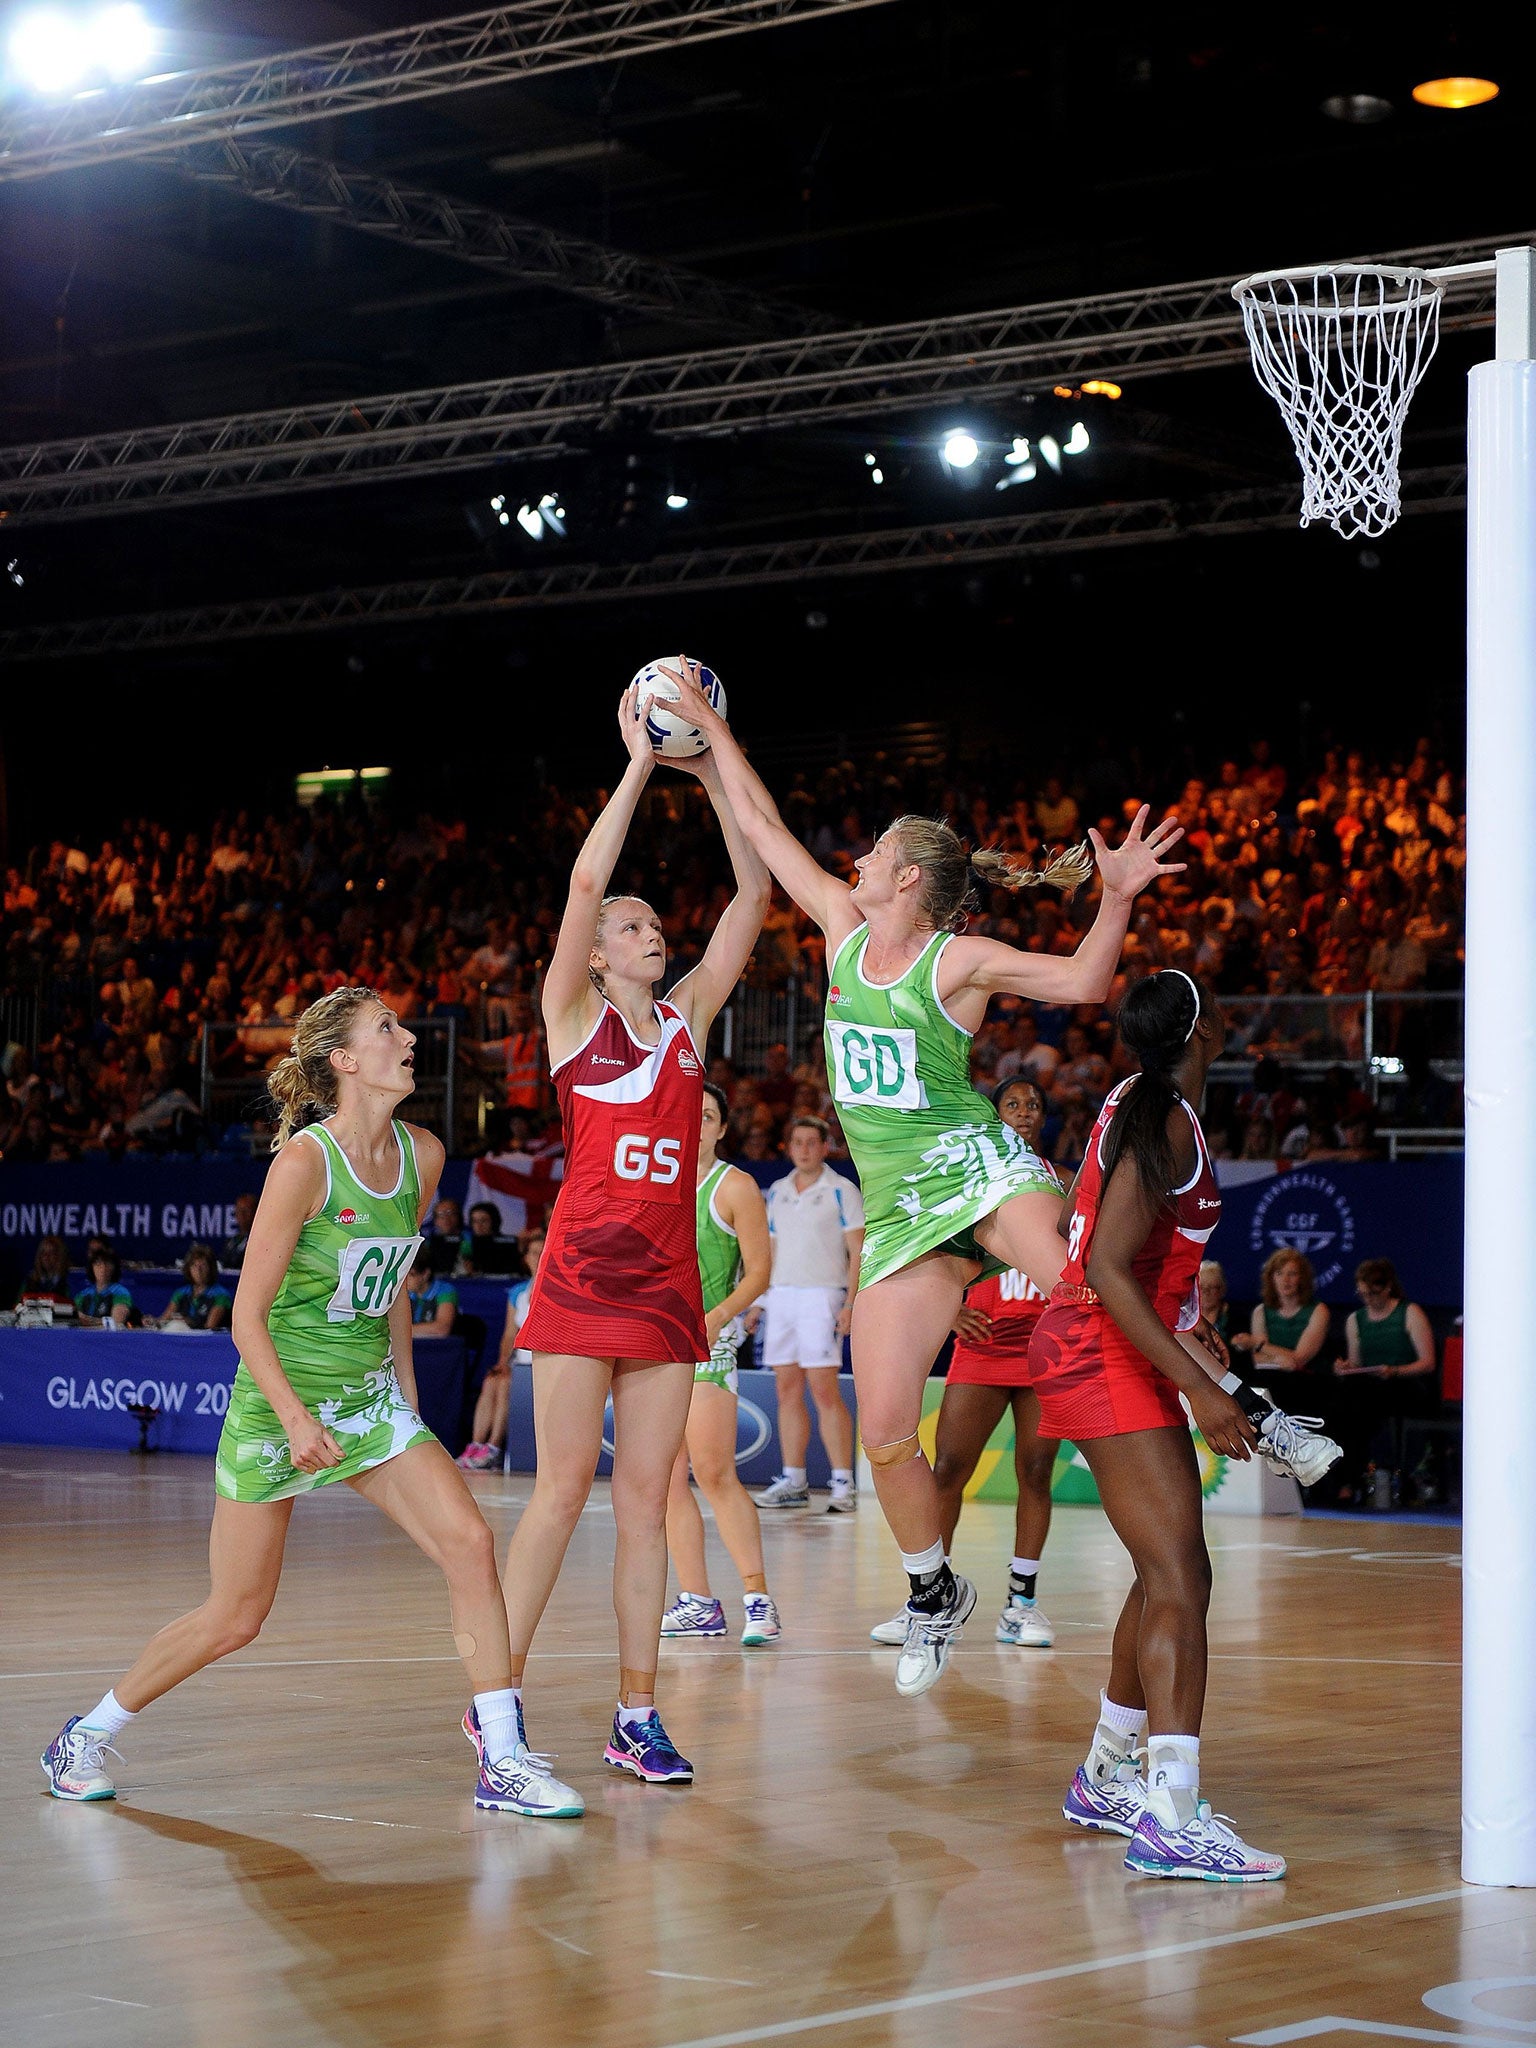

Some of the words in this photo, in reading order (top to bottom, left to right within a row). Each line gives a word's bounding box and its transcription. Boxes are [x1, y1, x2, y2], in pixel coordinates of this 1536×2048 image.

[599, 1057, 625, 1066] KUKRI
[842, 1028, 905, 1096] GD
[614, 1133, 681, 1184] GS
[352, 1244, 412, 1310] GK
[46, 1376, 188, 1412] GLASGOW
